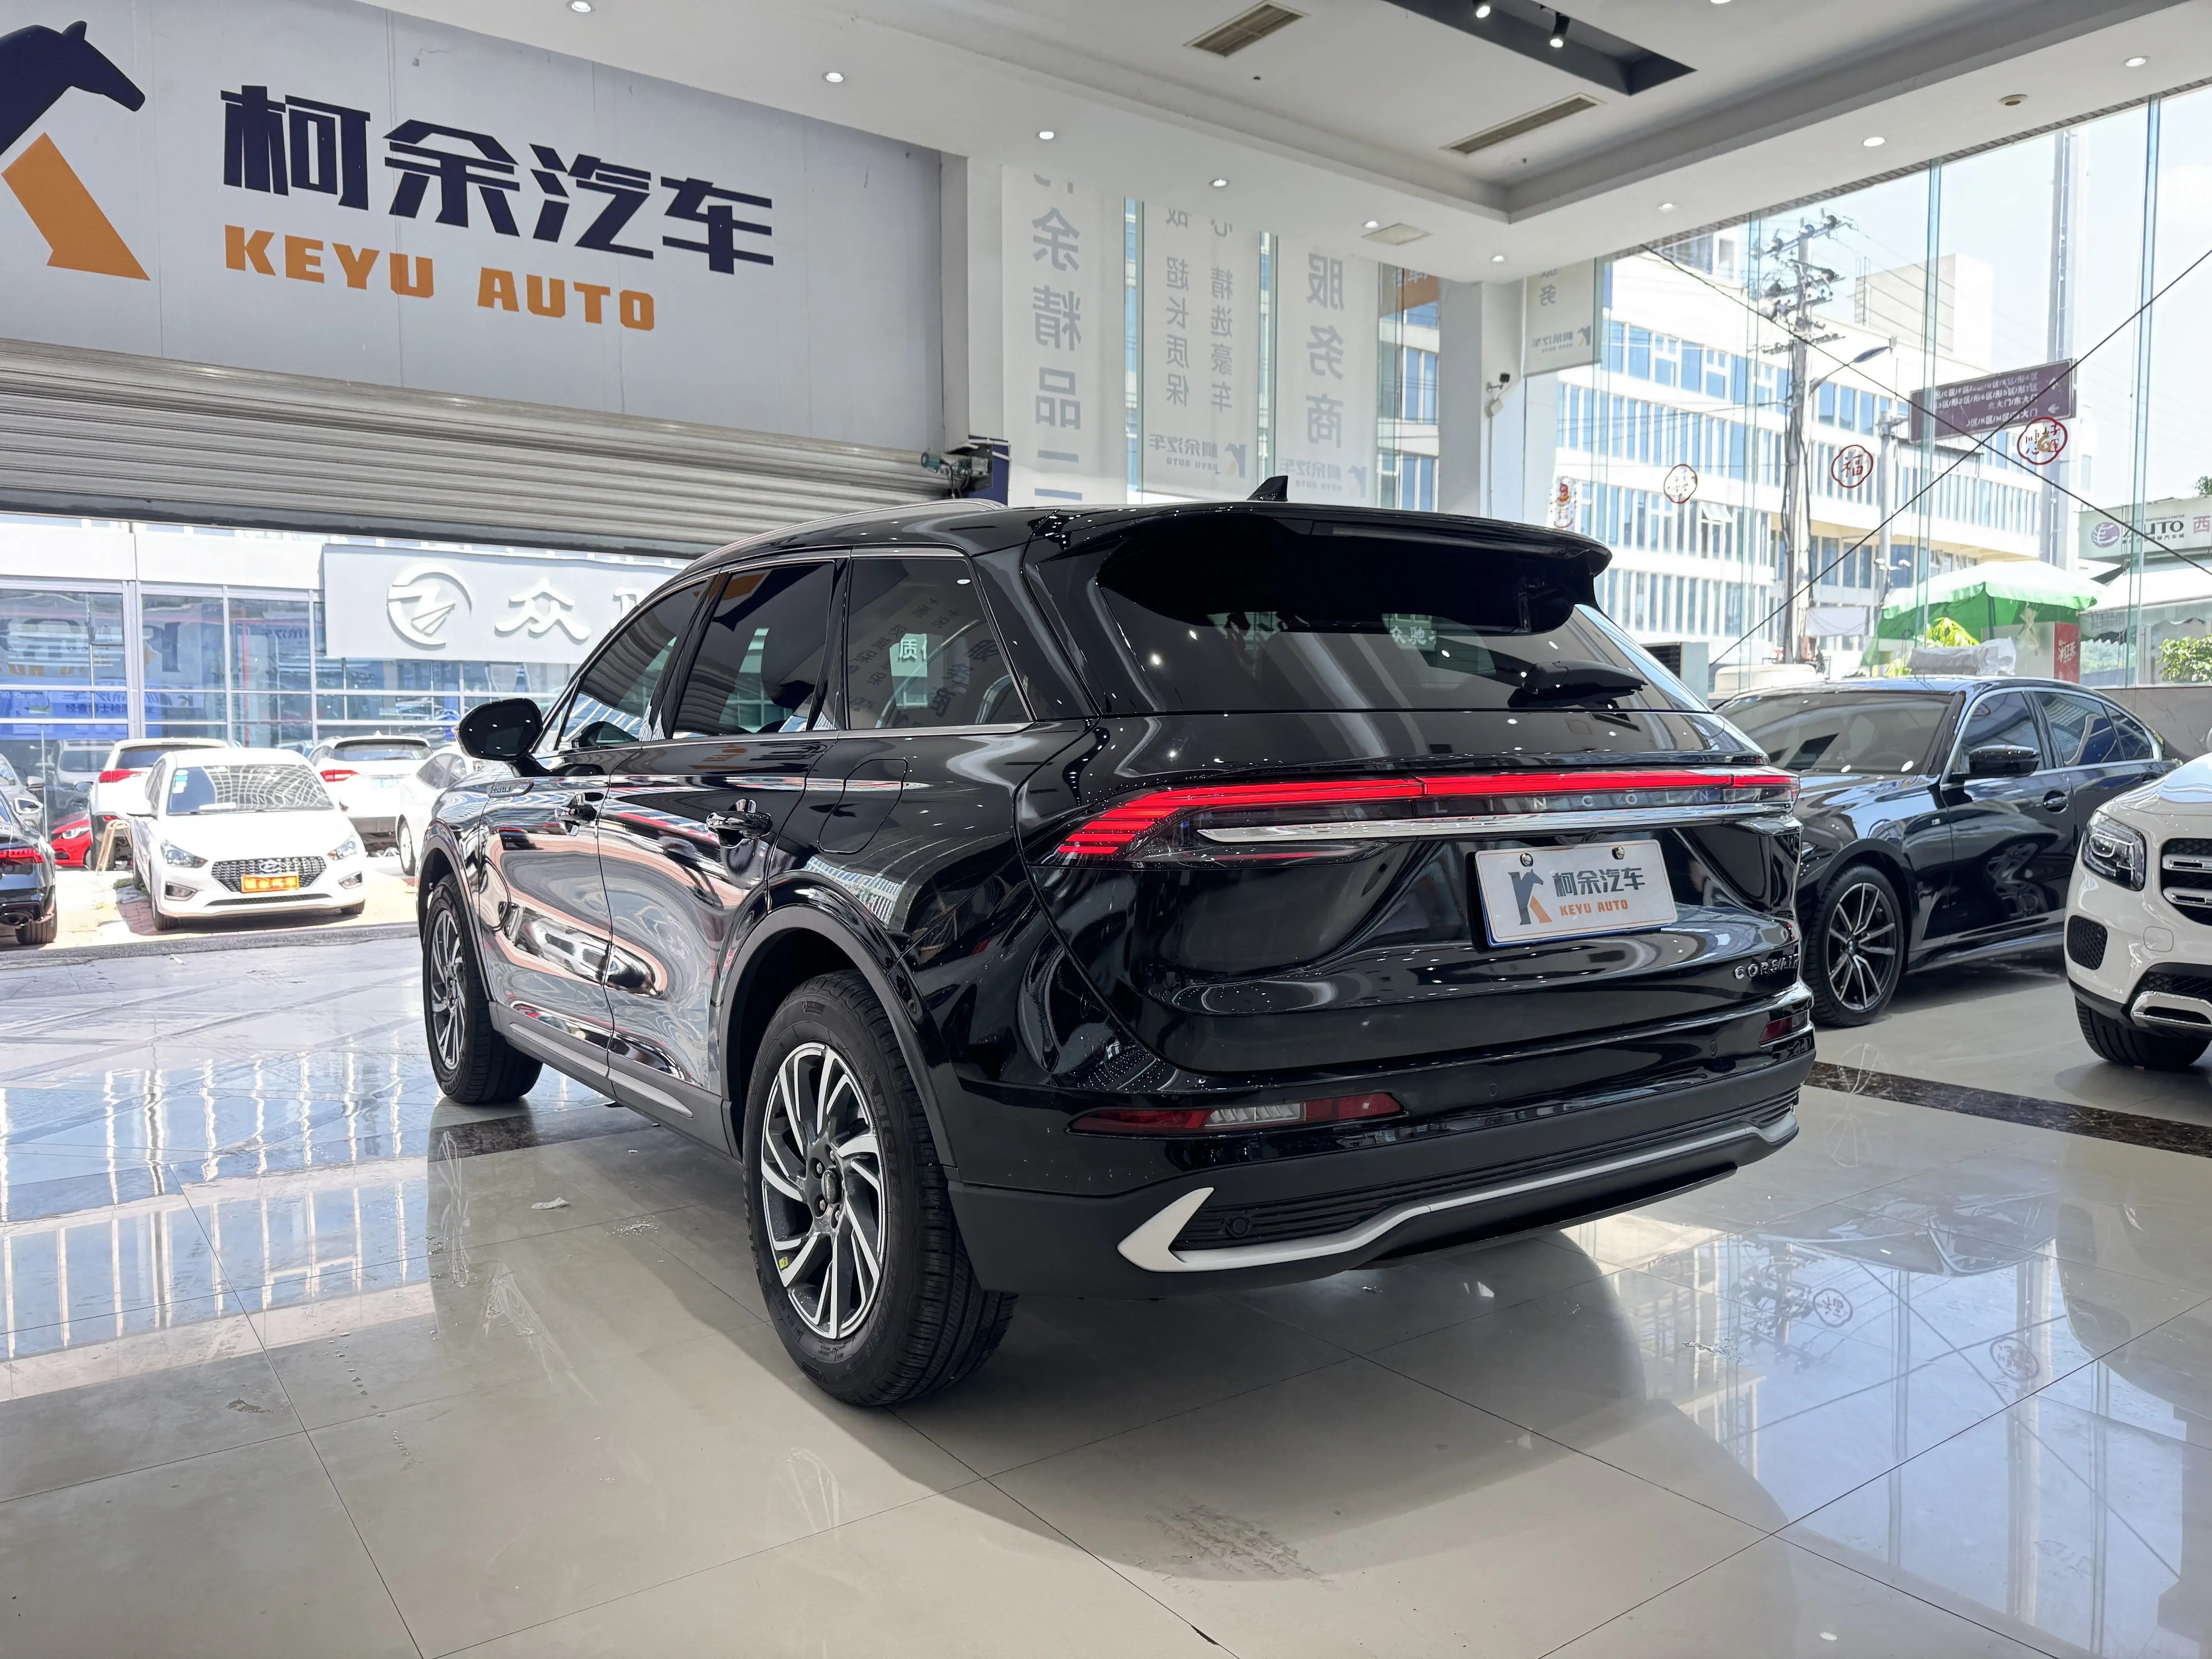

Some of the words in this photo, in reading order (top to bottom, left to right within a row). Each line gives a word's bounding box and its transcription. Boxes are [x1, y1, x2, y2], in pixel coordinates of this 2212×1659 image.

[220, 85, 774, 275] 柯余汽车
[225, 224, 433, 299] KEYU
[477, 268, 655, 331] AUTO
[1841, 454, 1863, 478] 福
[2193, 515, 2211, 534] 西
[495, 577, 639, 644] 众
[1553, 867, 1645, 897] 柯余汽车
[1559, 903, 1592, 916] KEYU
[1597, 899, 1628, 912] AUTO
[874, 1093, 903, 1257] MICHELIN
